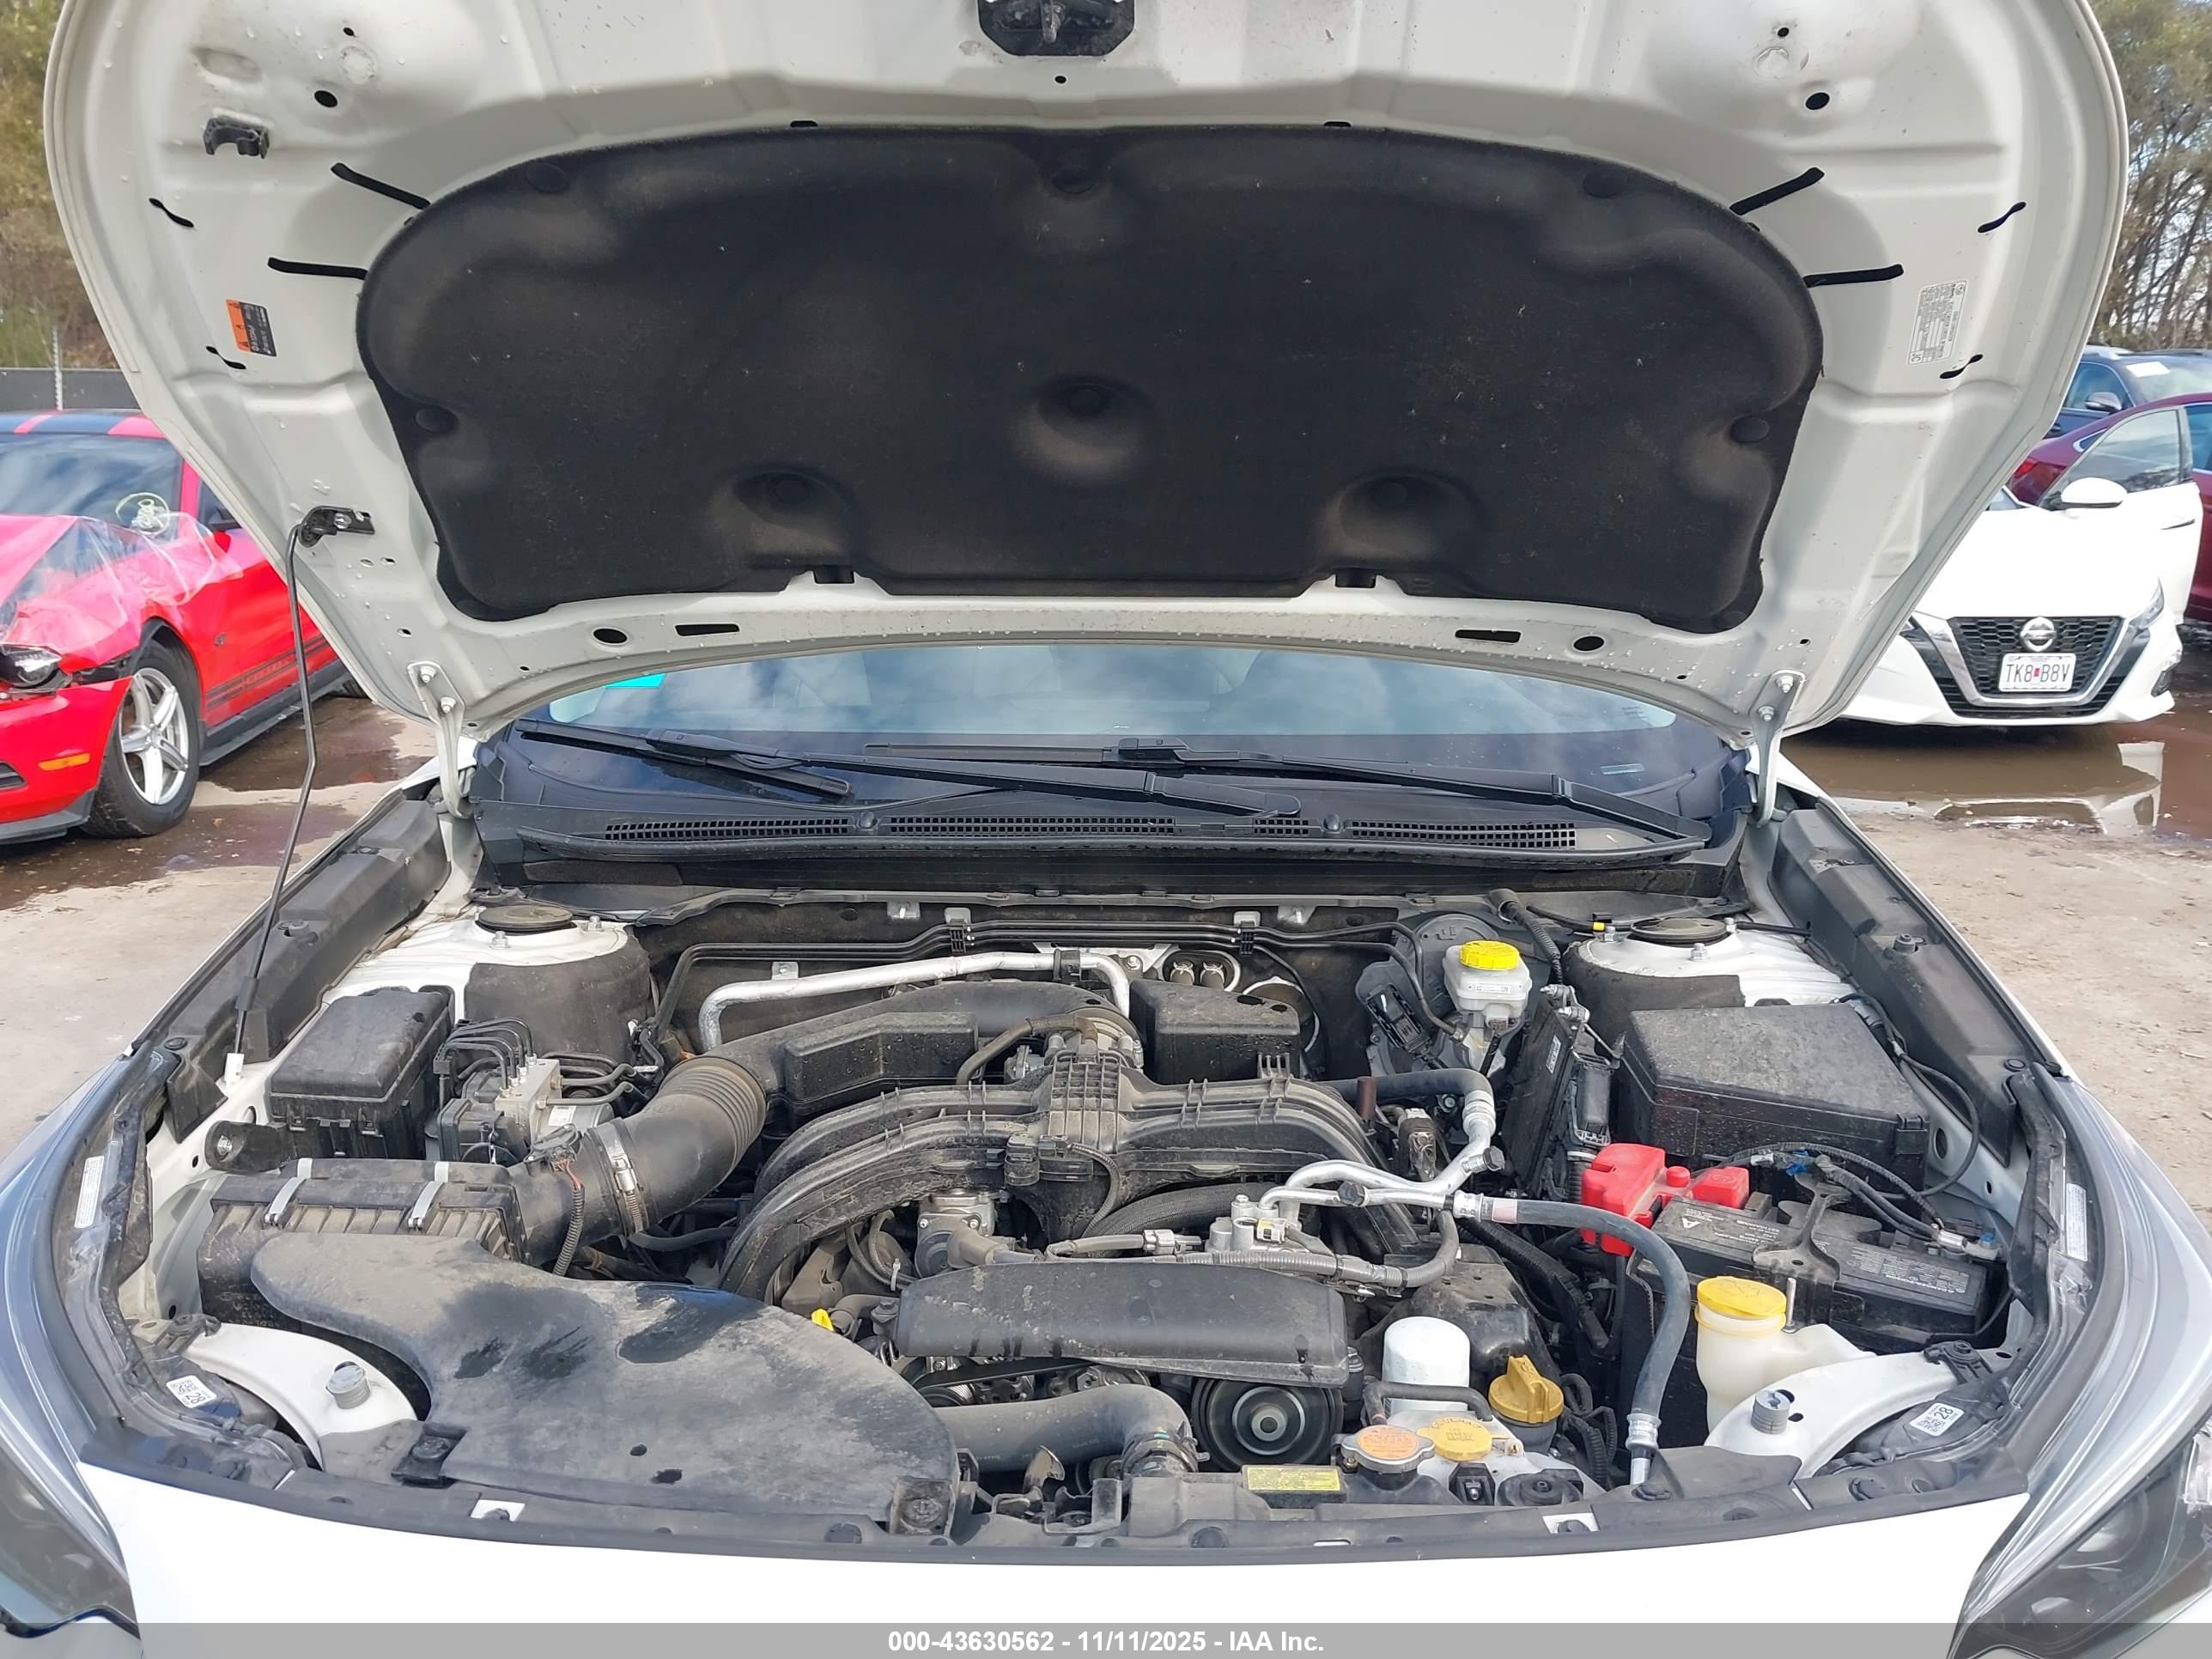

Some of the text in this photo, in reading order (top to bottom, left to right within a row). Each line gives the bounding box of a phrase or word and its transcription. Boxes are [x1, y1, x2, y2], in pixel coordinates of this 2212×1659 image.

[2006, 663, 2034, 683] TK8
[185, 1392, 206, 1404] 28
[1934, 1407, 1954, 1419] 28
